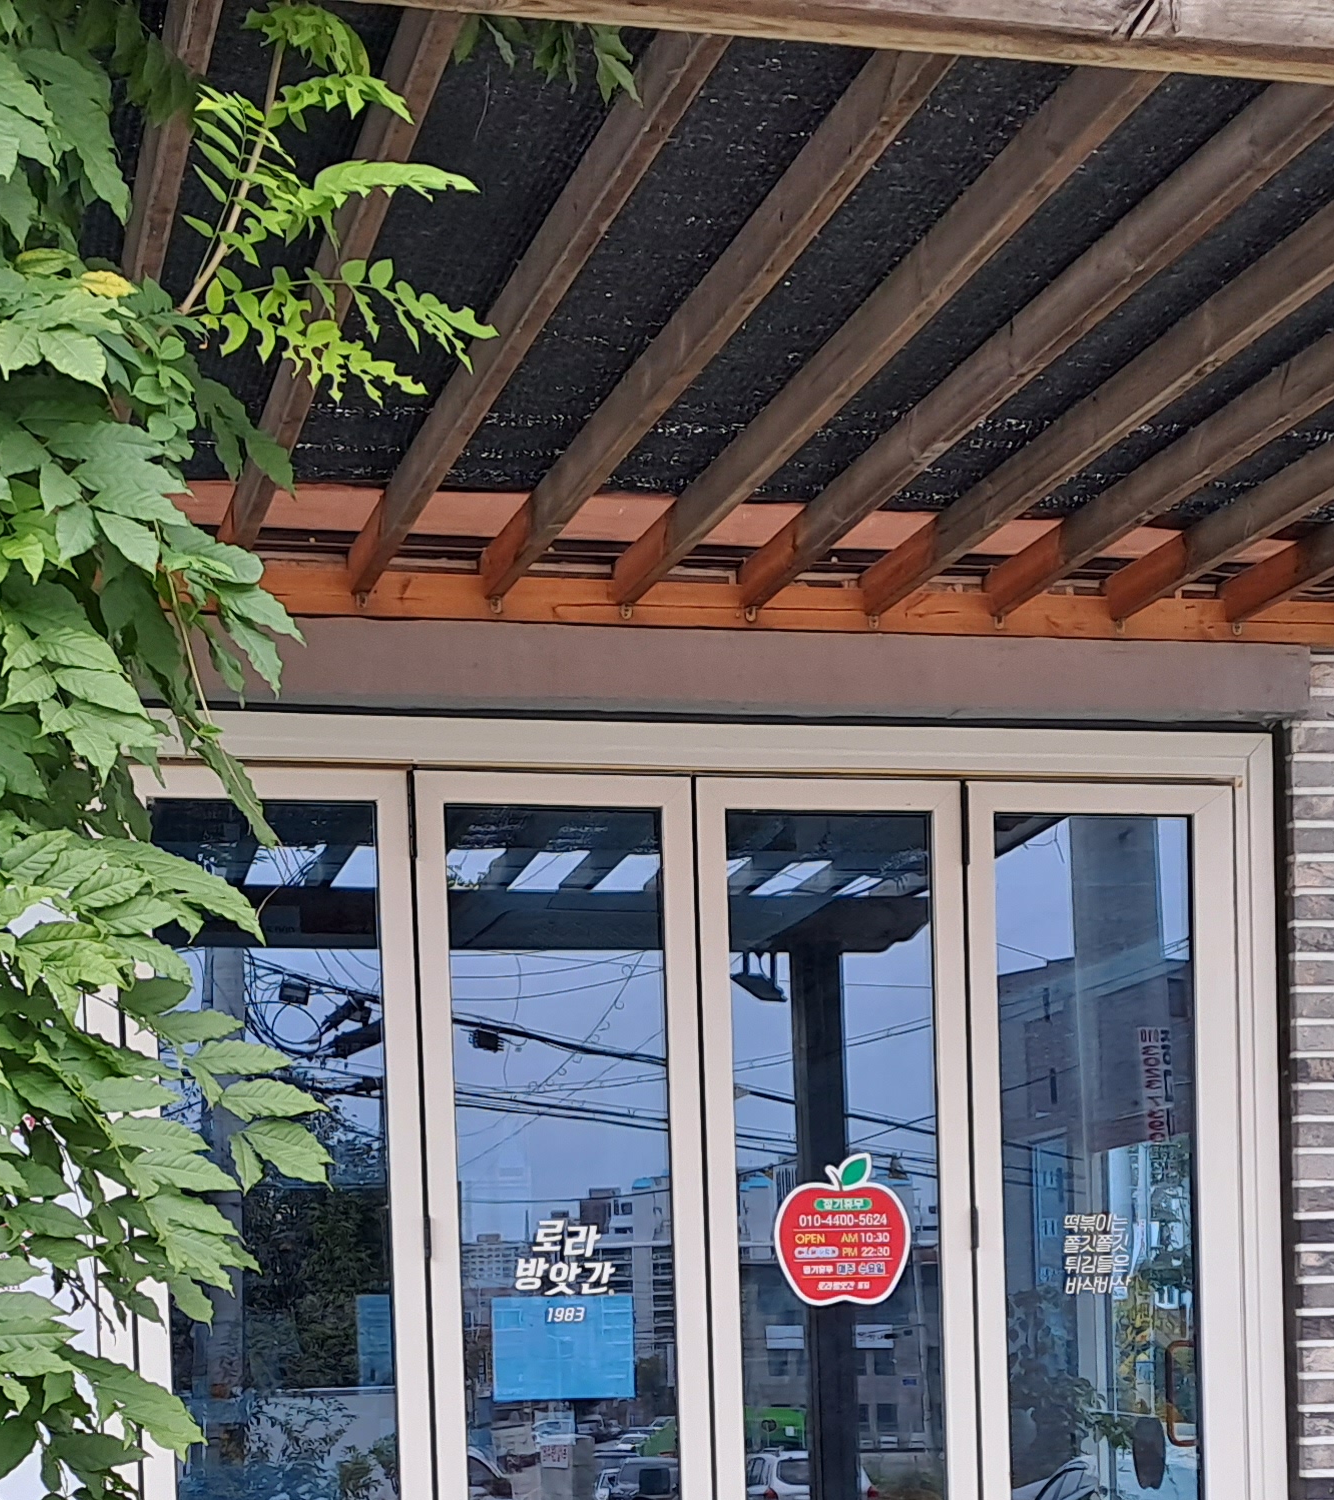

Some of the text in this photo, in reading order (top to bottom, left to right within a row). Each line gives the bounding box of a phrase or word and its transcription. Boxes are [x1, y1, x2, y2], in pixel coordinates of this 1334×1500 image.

[1063, 1213, 1129, 1232] 떡볶이는
[532, 1219, 602, 1257] 로라
[795, 1232, 890, 1244] OPEN AM 10:30
[1063, 1234, 1129, 1254] 쫄깃쫄깃
[842, 1247, 858, 1257] PM
[858, 1262, 886, 1275] 수요일
[1064, 1254, 1130, 1275] 튀김들은
[515, 1258, 616, 1296] 방앗간
[1064, 1275, 1132, 1295] 바삭바삭
[546, 1306, 586, 1323] 1983
